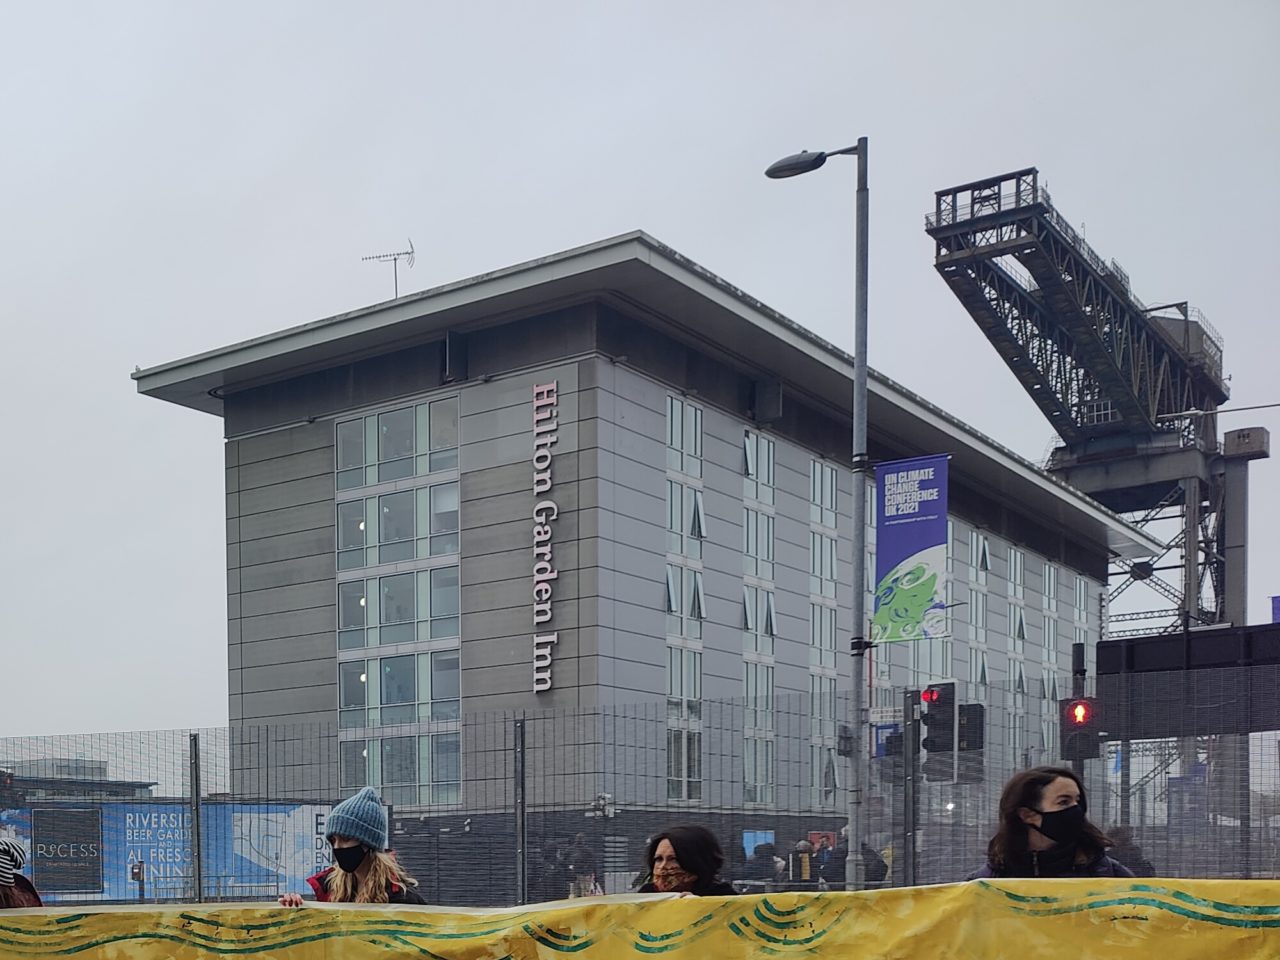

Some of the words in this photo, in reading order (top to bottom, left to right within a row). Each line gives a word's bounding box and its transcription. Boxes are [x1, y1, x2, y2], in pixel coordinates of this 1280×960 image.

[533, 380, 558, 496] Hilton
[885, 473, 897, 485] UN
[898, 467, 935, 483] CLIMATE
[885, 480, 920, 496] CHANGE
[885, 488, 939, 506] CONFERENCE
[885, 504, 897, 517] UK
[898, 502, 919, 515] 2021
[533, 500, 558, 626] Garden
[533, 632, 558, 694] Inn
[126, 813, 192, 828] RIVERSID
[126, 829, 152, 840] BEER
[127, 849, 144, 862] AL
